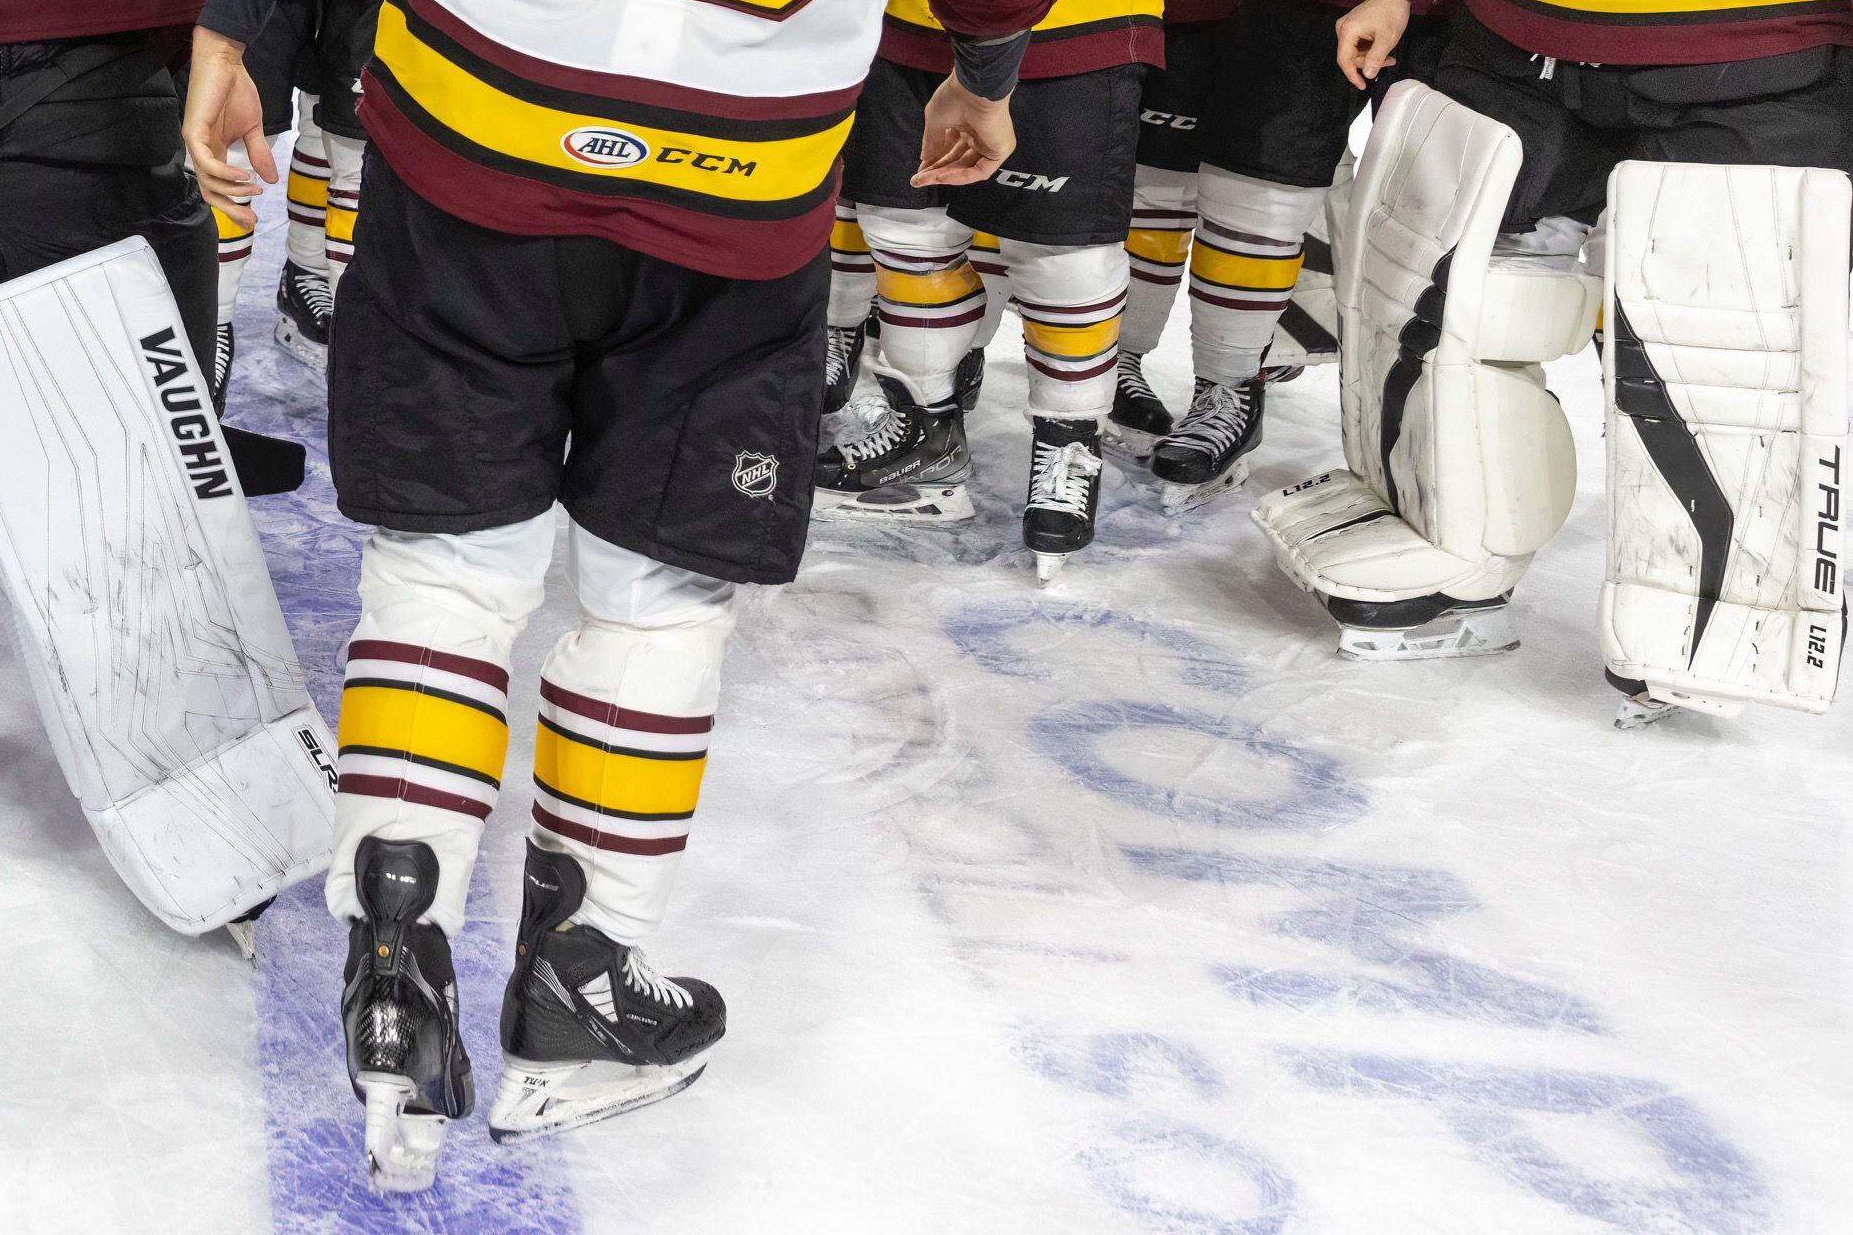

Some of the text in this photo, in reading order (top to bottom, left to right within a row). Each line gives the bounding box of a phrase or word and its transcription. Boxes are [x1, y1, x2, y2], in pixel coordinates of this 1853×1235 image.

[577, 136, 758, 177] AHL CCM
[995, 168, 1071, 194] CM
[139, 325, 235, 500] VAUGHN
[740, 464, 773, 486] NHL
[1813, 444, 1841, 595] TRUE
[297, 728, 339, 795] SLR
